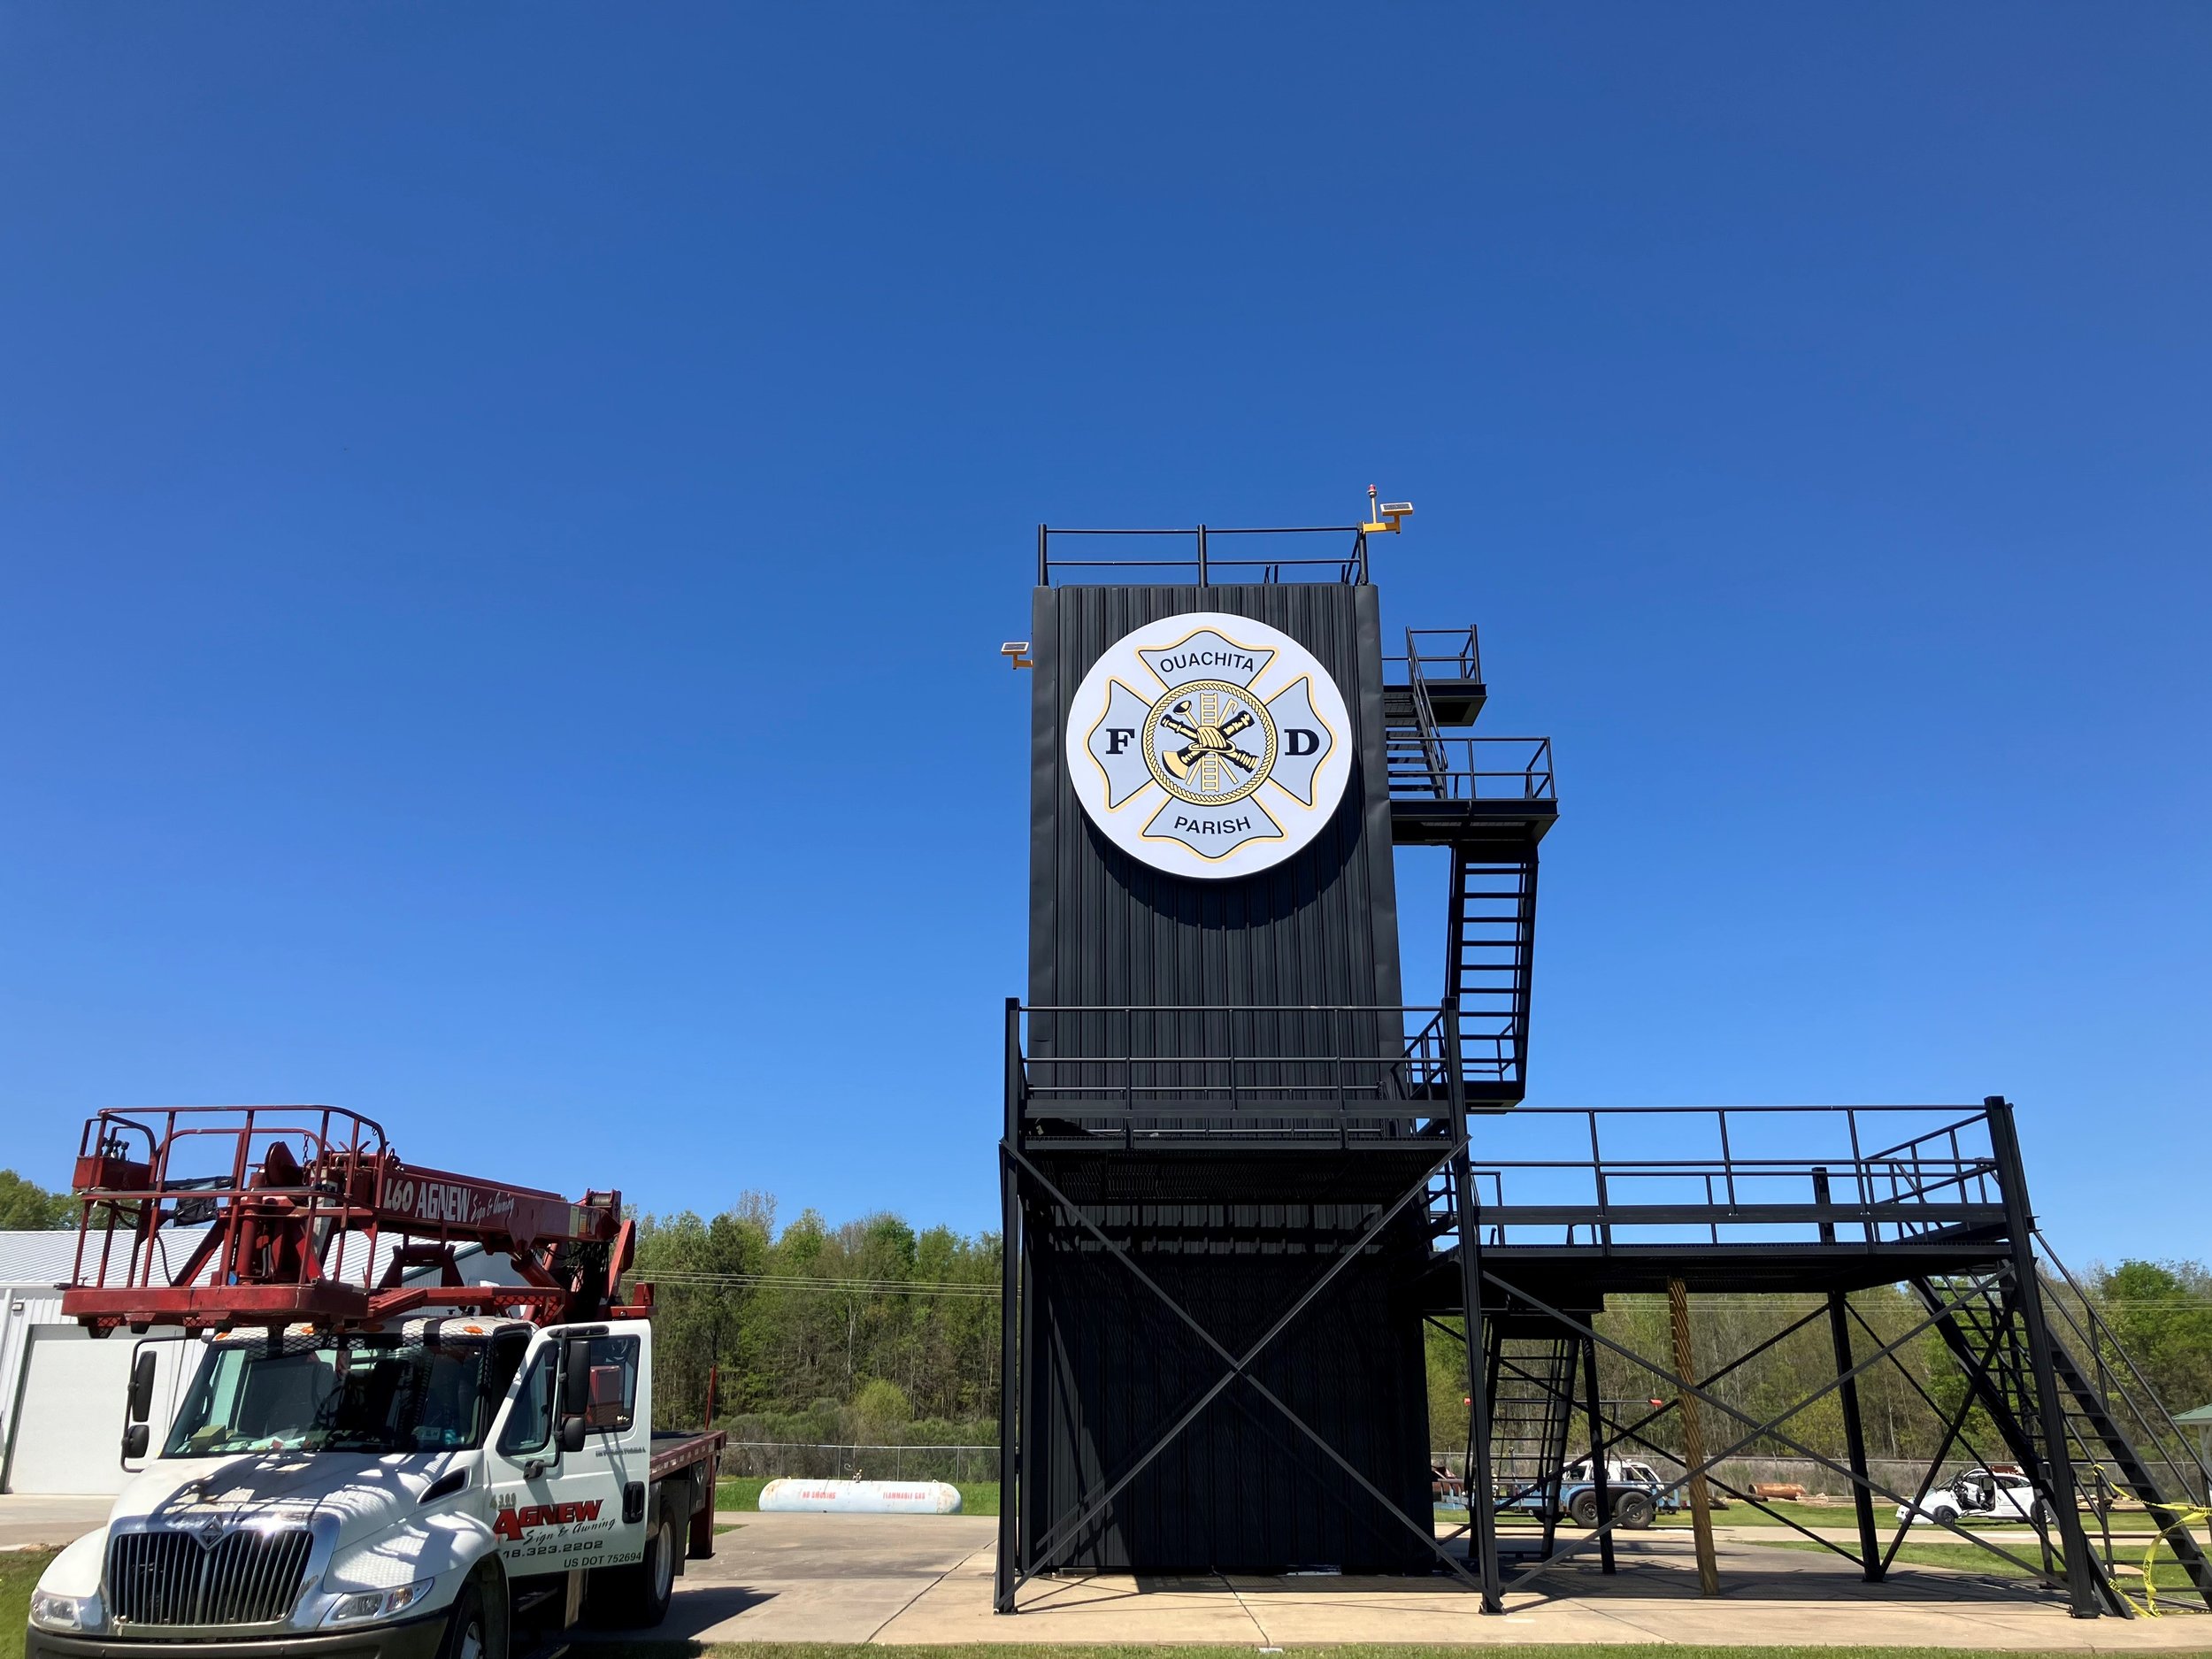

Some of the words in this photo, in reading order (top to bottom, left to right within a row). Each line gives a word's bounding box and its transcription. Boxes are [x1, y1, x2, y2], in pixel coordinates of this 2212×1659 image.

[1160, 651, 1254, 672] OUACHITA
[1105, 727, 1135, 755] F
[1284, 728, 1320, 756] D
[1173, 815, 1252, 834] PARISH
[383, 1178, 414, 1212] L60
[415, 1182, 471, 1223] AGNEW
[492, 1498, 604, 1542] AGNEW
[523, 1529, 554, 1547] Sign
[557, 1525, 569, 1538] &
[572, 1517, 617, 1535] Awning
[564, 1557, 579, 1569] US
[581, 1555, 605, 1567] DOT
[607, 1551, 642, 1564] 752694
